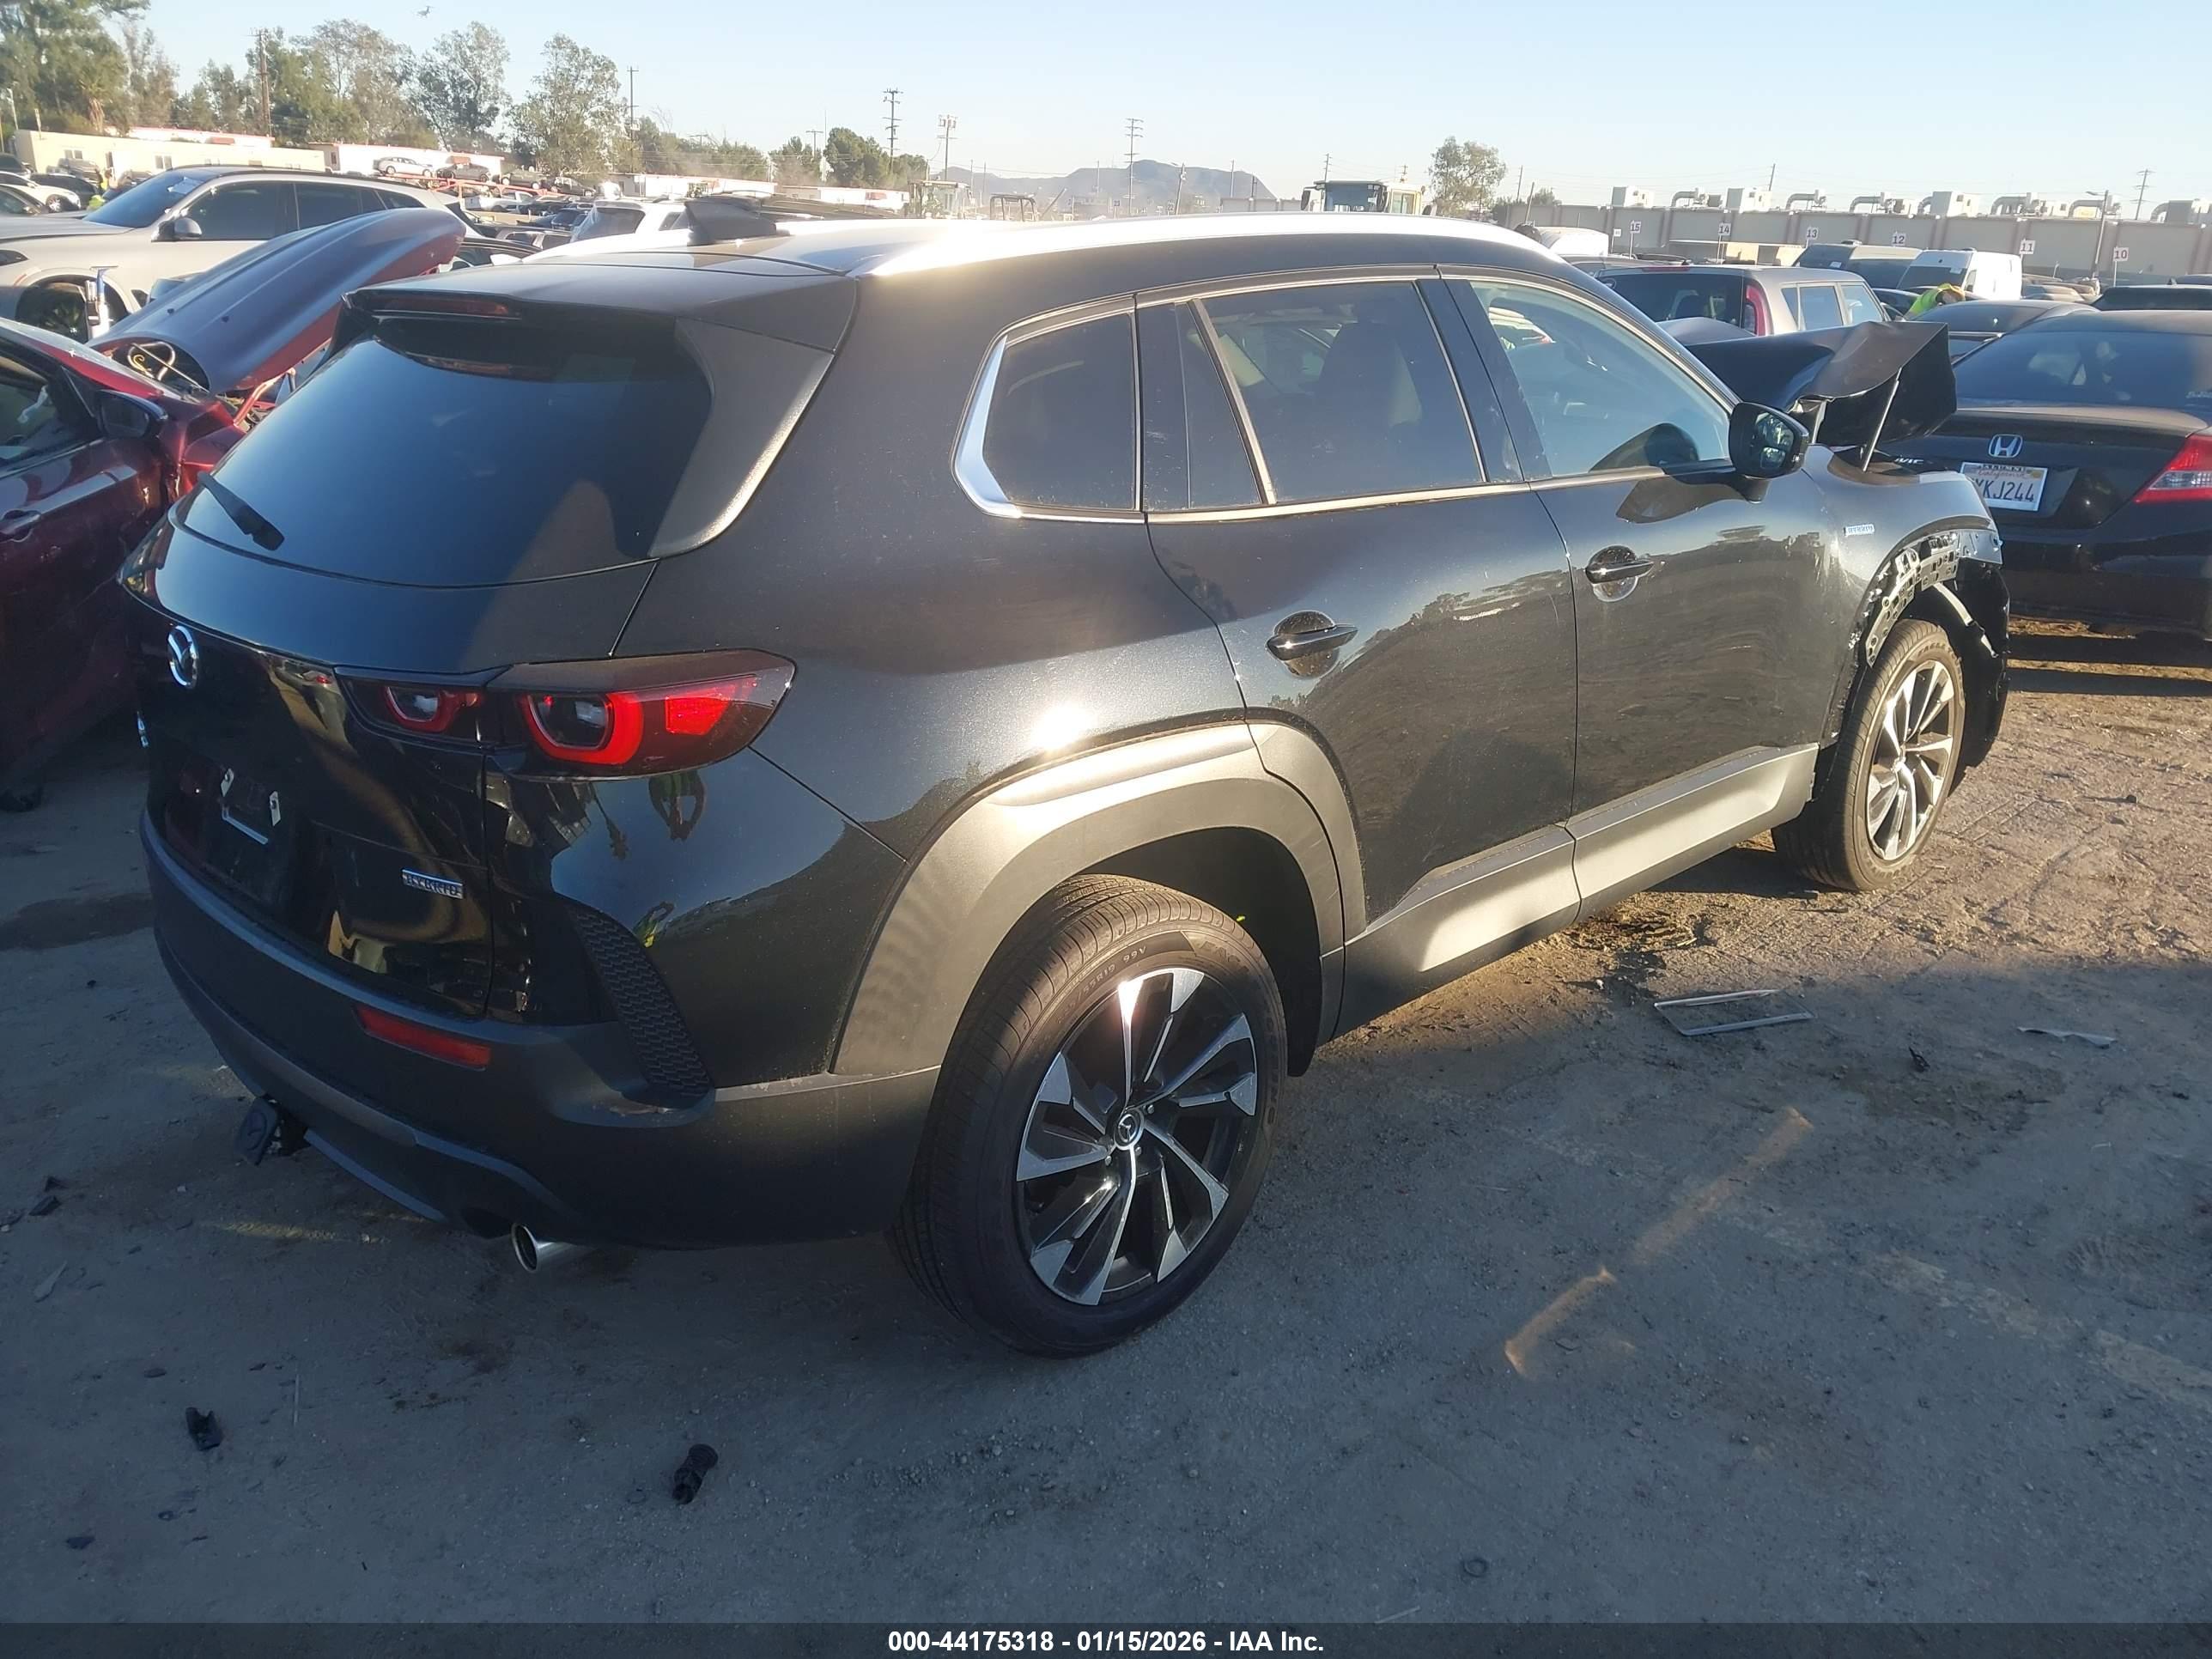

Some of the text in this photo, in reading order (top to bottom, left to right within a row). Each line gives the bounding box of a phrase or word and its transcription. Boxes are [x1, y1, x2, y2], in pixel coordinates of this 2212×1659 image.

[1630, 222, 1641, 233] 15
[1719, 224, 1730, 234] 14
[1807, 228, 1818, 239] 13
[1893, 235, 1905, 245] 12
[2021, 243, 2034, 252] 11
[2114, 250, 2128, 259] 10
[1123, 945, 1146, 964] 99V
